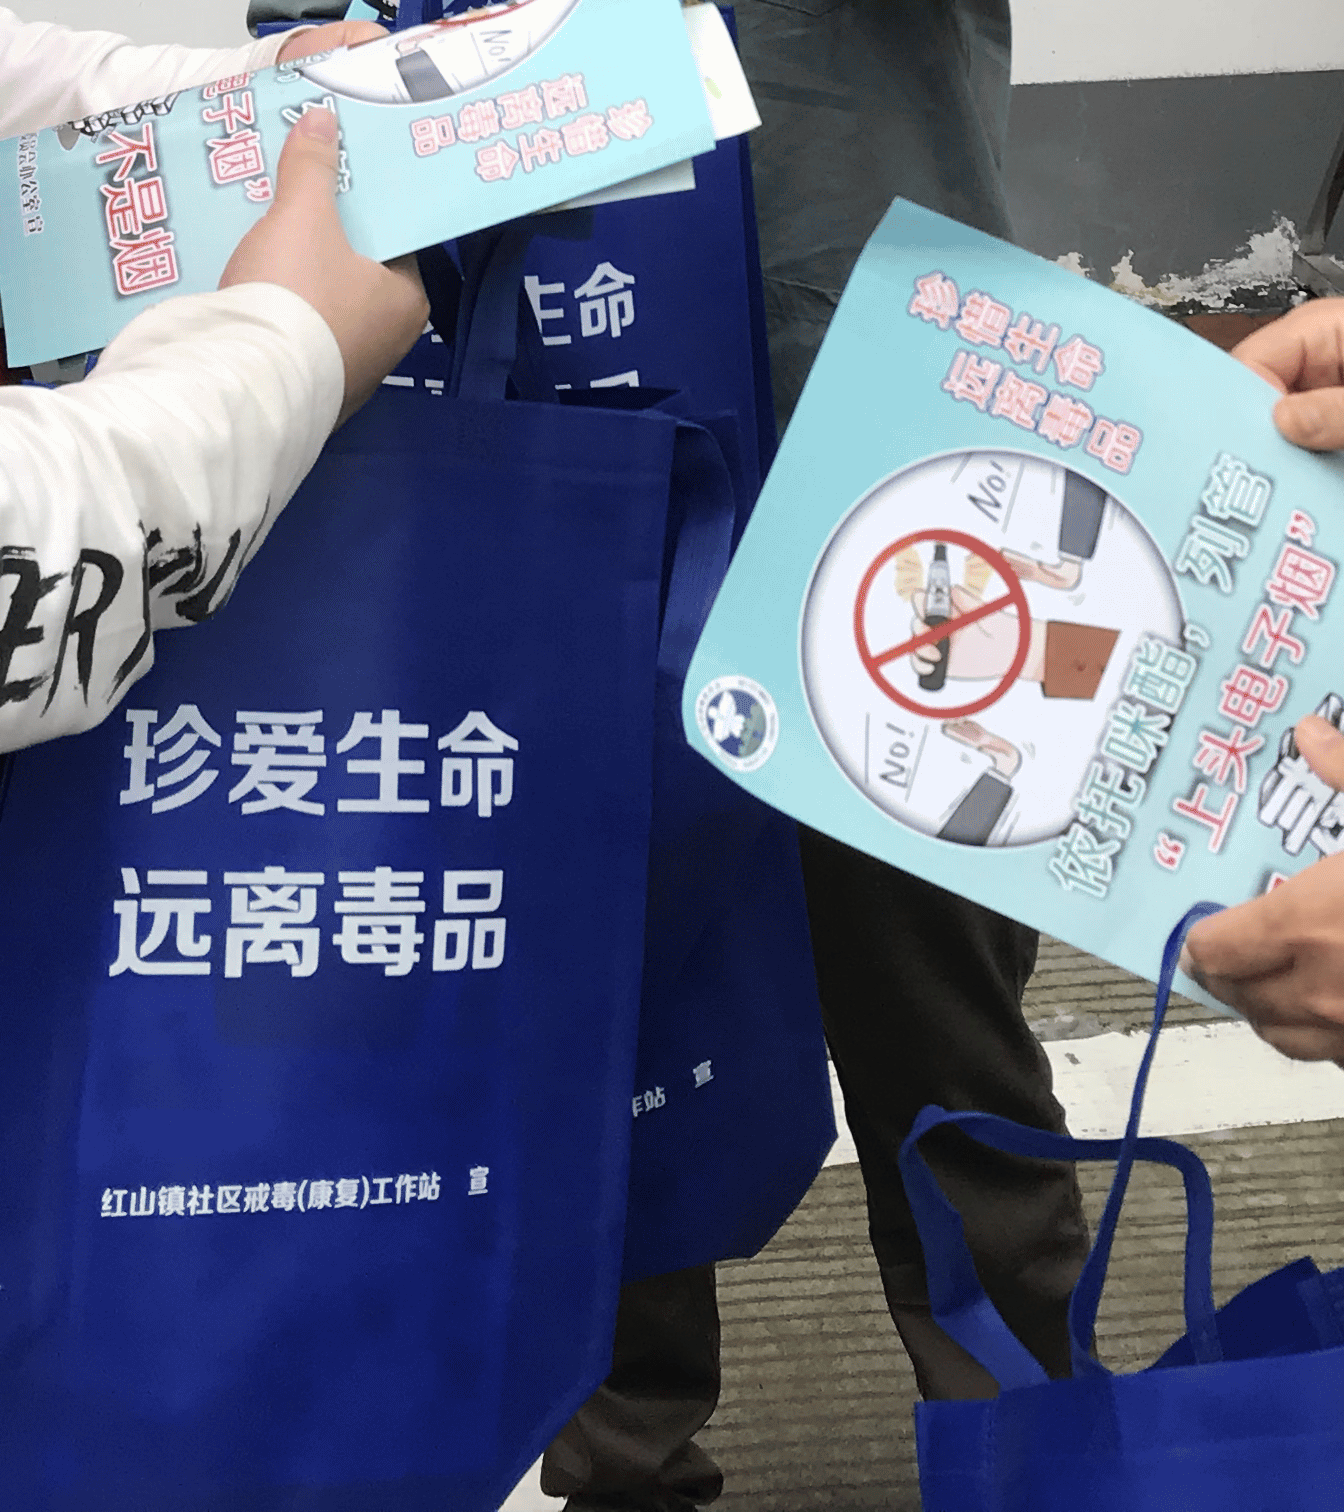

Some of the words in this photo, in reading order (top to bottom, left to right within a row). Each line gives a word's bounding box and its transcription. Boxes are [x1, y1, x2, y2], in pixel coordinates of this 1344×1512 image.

[907, 270, 1106, 392] 珍惜生命
[940, 348, 1144, 476] 远离毒品
[119, 704, 520, 818] 珍爱生命
[108, 865, 508, 979] 远离毒品
